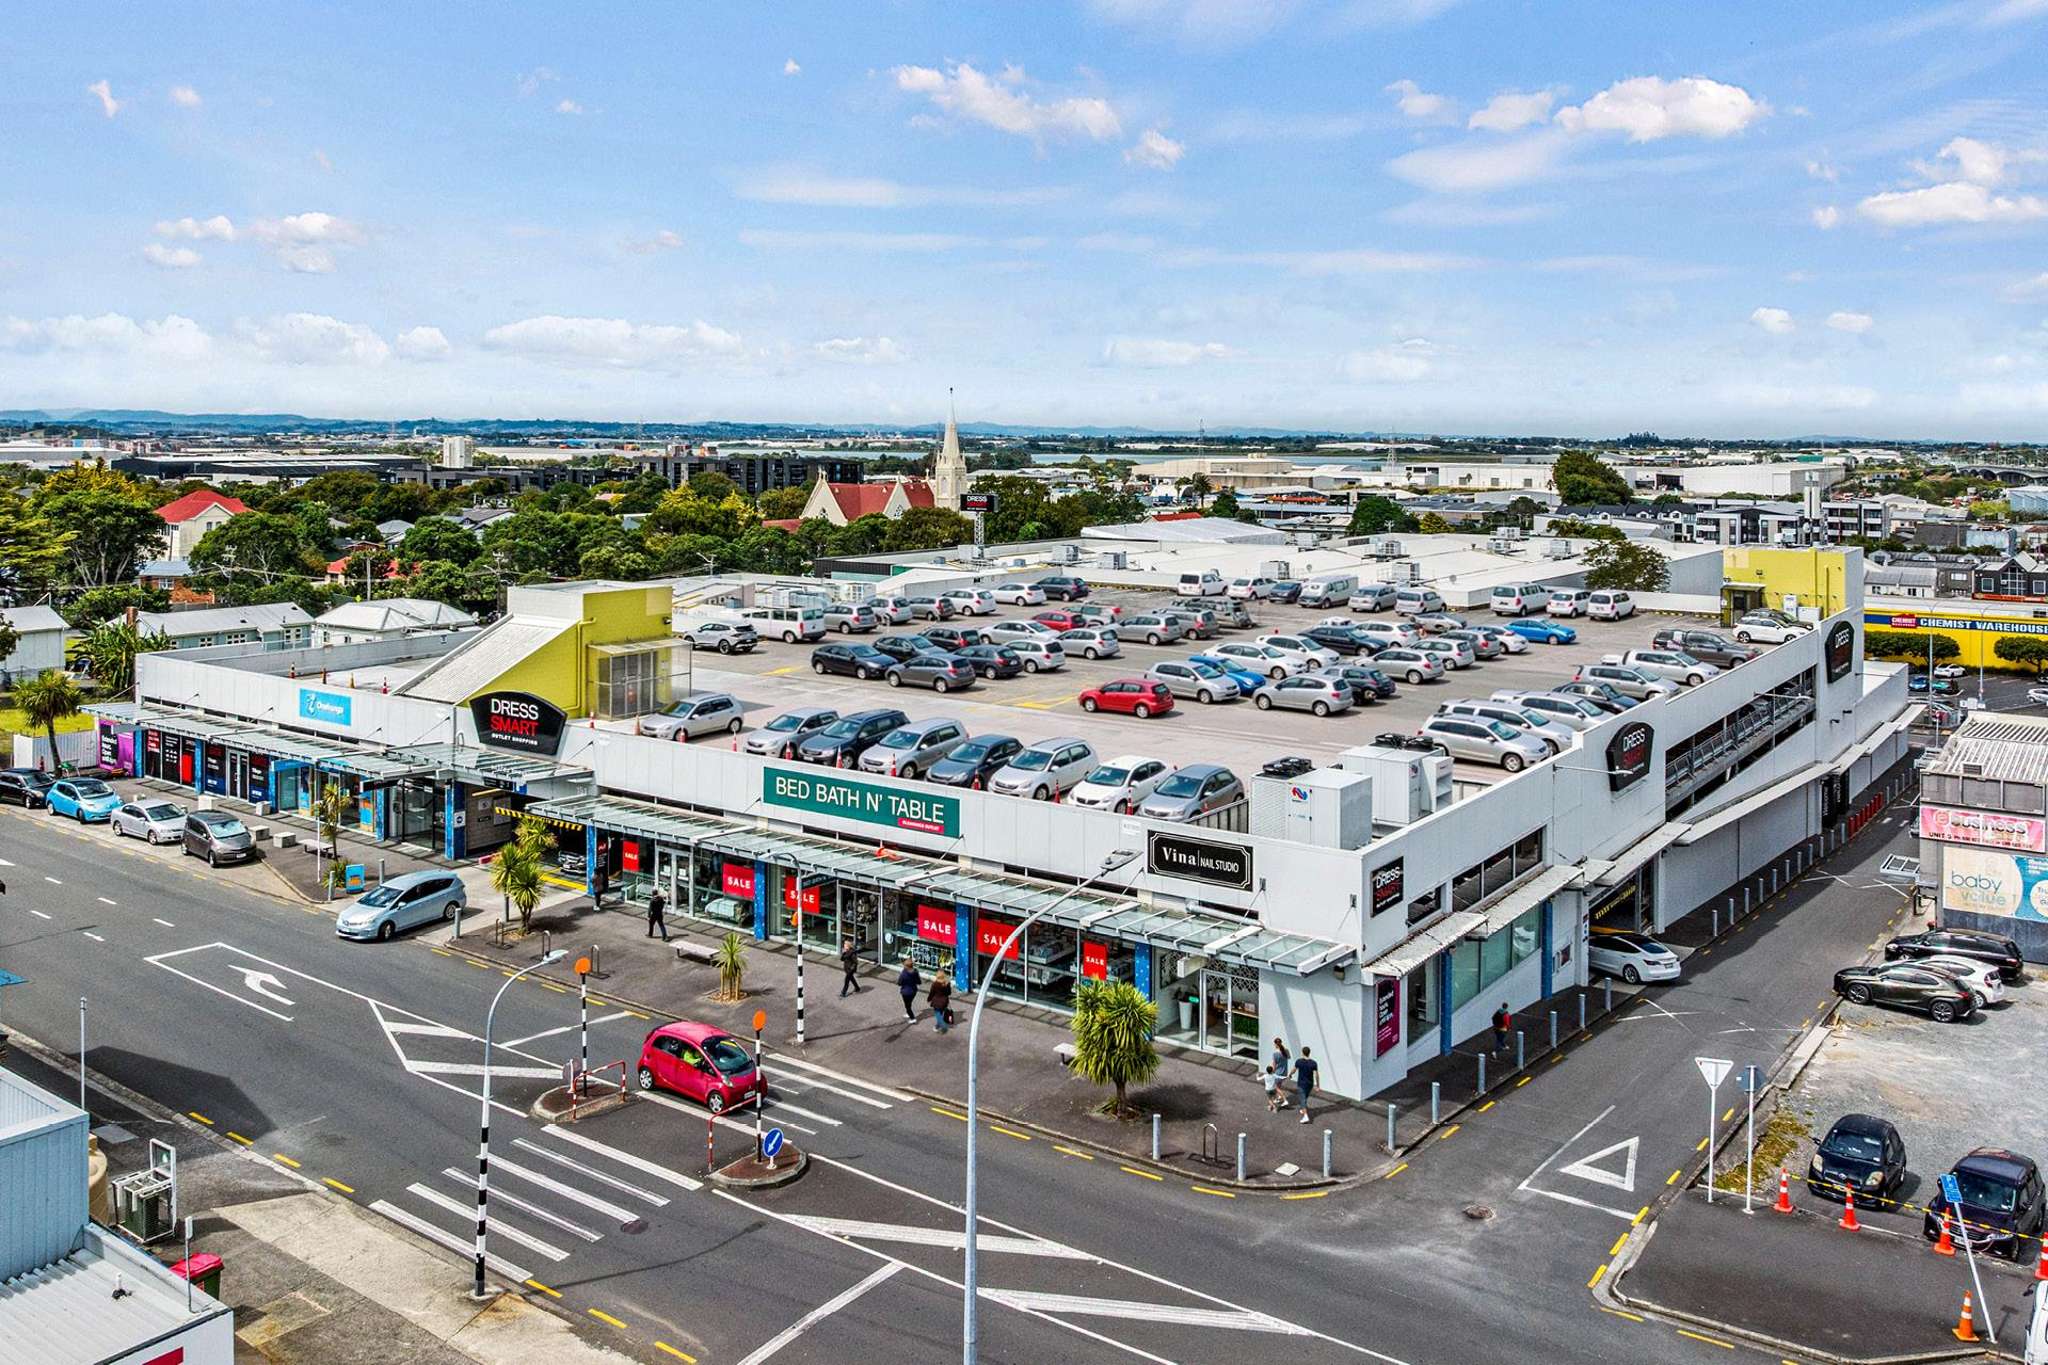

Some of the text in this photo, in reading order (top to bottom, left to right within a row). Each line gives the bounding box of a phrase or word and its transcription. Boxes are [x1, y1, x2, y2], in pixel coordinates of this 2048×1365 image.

[1920, 617, 1972, 629] CHEMIST
[1834, 628, 1850, 649] DRESS
[490, 698, 539, 720] DRESS
[490, 714, 539, 737] SMART
[491, 732, 511, 741] OUTLET
[1623, 727, 1646, 752] DRESS
[775, 776, 811, 800] BED
[816, 783, 860, 809] BATH
[888, 795, 945, 824] TABLE
[624, 852, 638, 861] SALE
[1162, 846, 1240, 873] Vina NAIL STUDIO
[727, 876, 752, 889] SALE
[1376, 866, 1401, 889] DRESS
[1951, 869, 2003, 895] baby
[789, 890, 815, 904] SLE
[923, 919, 952, 935] SALE
[983, 934, 1013, 949] SAL
[1086, 956, 1105, 967] SALE
